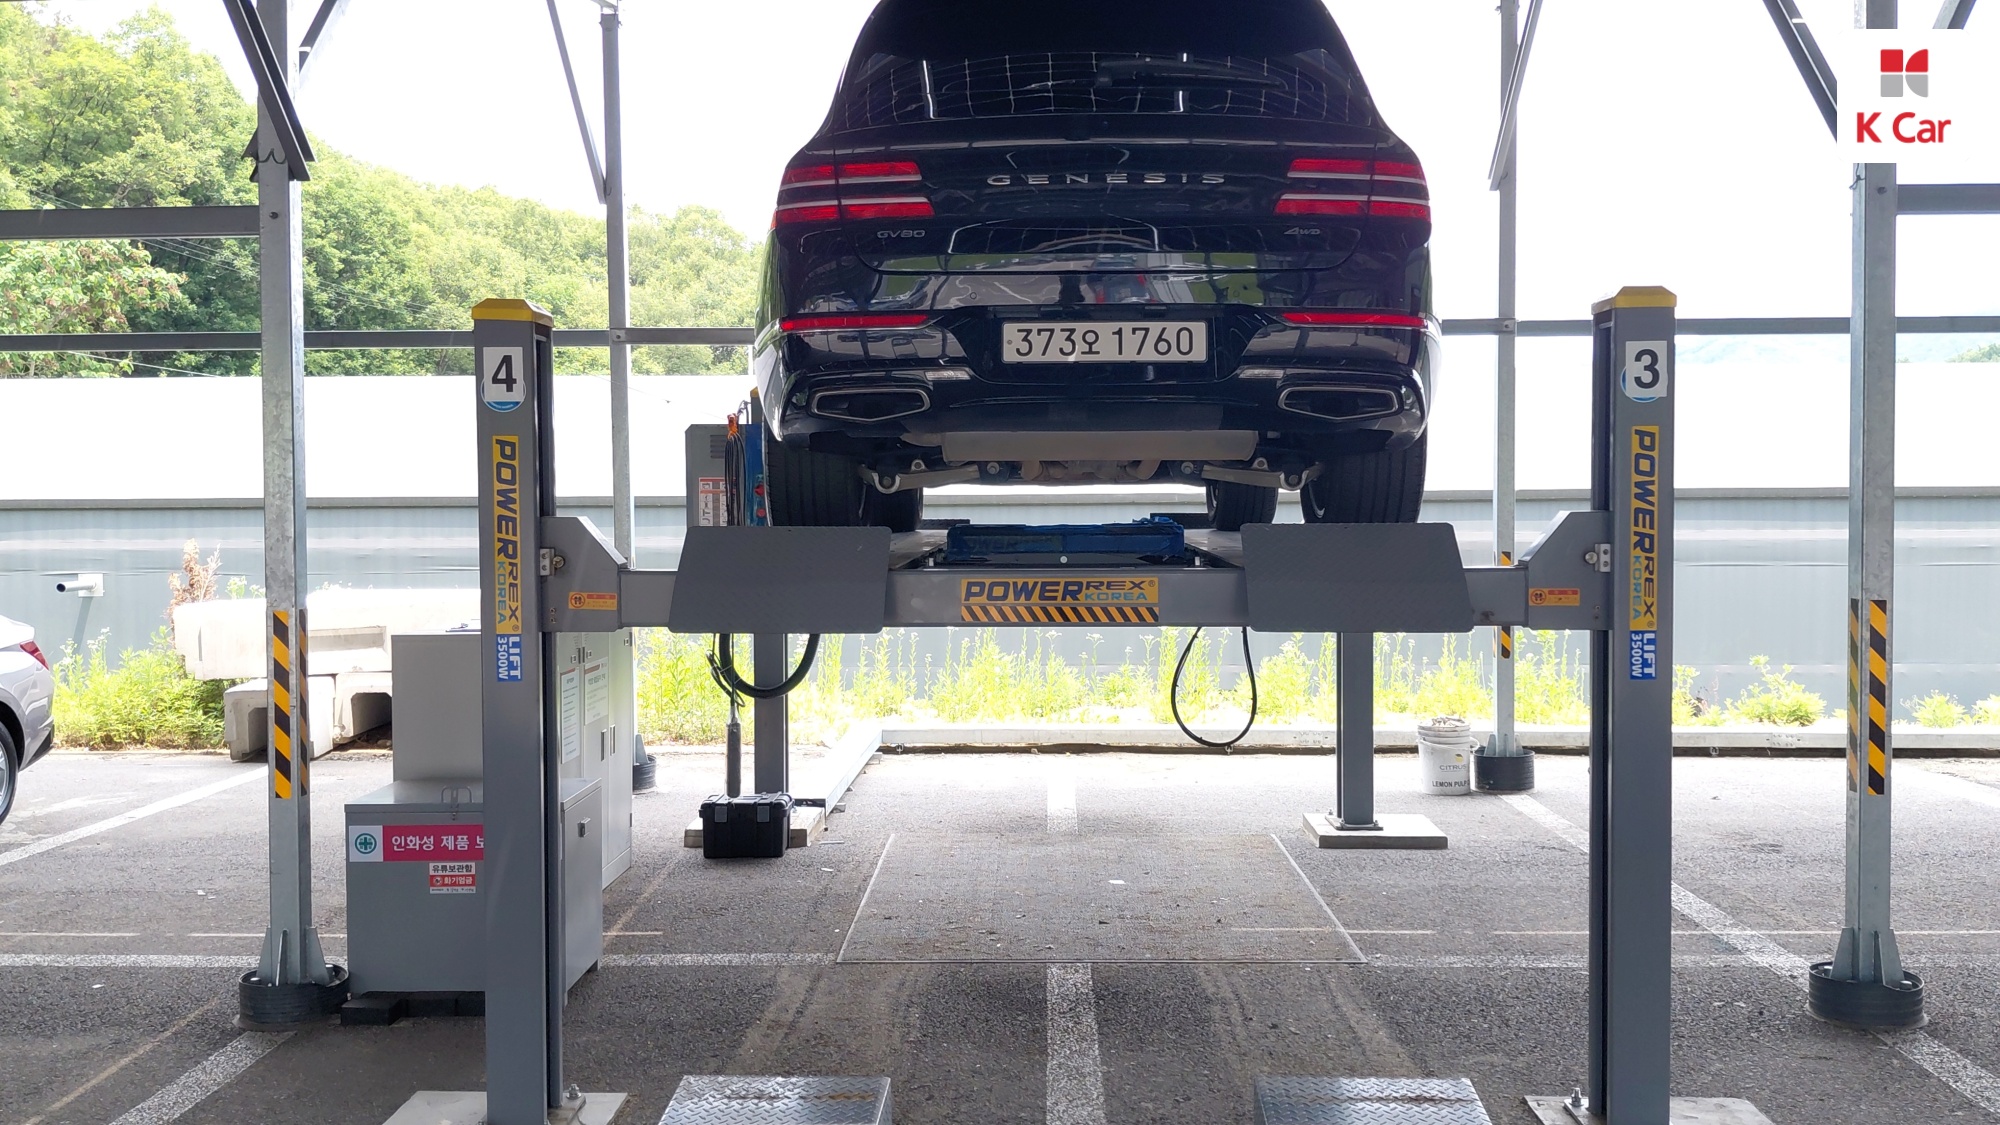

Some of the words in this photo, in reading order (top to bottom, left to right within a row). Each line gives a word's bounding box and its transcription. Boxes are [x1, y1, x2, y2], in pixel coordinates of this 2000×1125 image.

[986, 173, 1226, 186] GENESIS
[876, 229, 926, 239] GV80
[1283, 226, 1321, 235] 4WD
[1015, 327, 1101, 357] 373오
[1111, 326, 1194, 356] 1760
[491, 354, 518, 393] 4
[1633, 348, 1661, 390] 3
[497, 561, 507, 624] KOREA
[1084, 591, 1148, 601] KOREA
[1632, 555, 1642, 620] KOREA
[497, 636, 509, 680] 3500W
[509, 635, 521, 680] LIFT
[1631, 633, 1643, 678] 3500W
[1643, 632, 1656, 678] LIFT
[391, 834, 435, 852] 인화성
[440, 834, 470, 851] 제품
